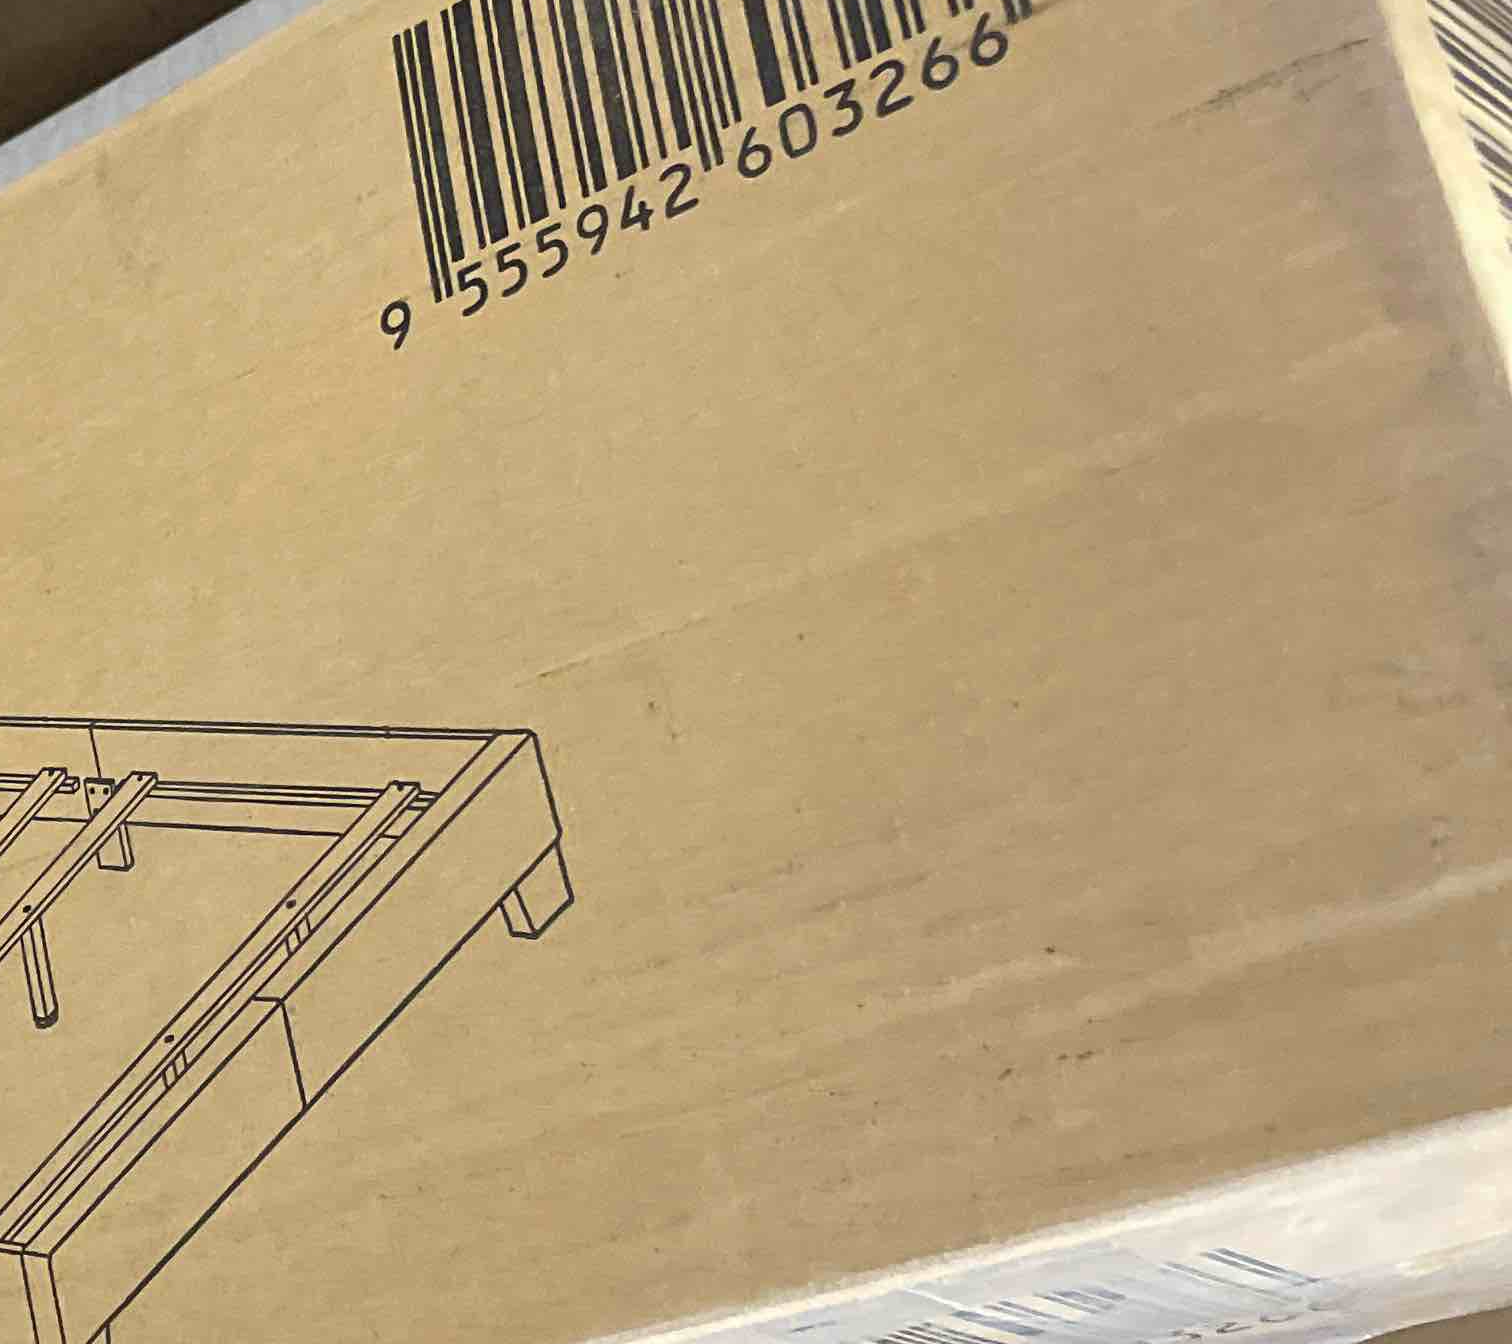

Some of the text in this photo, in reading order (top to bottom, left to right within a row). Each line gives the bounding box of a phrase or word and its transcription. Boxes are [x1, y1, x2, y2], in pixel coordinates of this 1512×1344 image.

[379, 11, 1009, 350] 9 555942 603266
